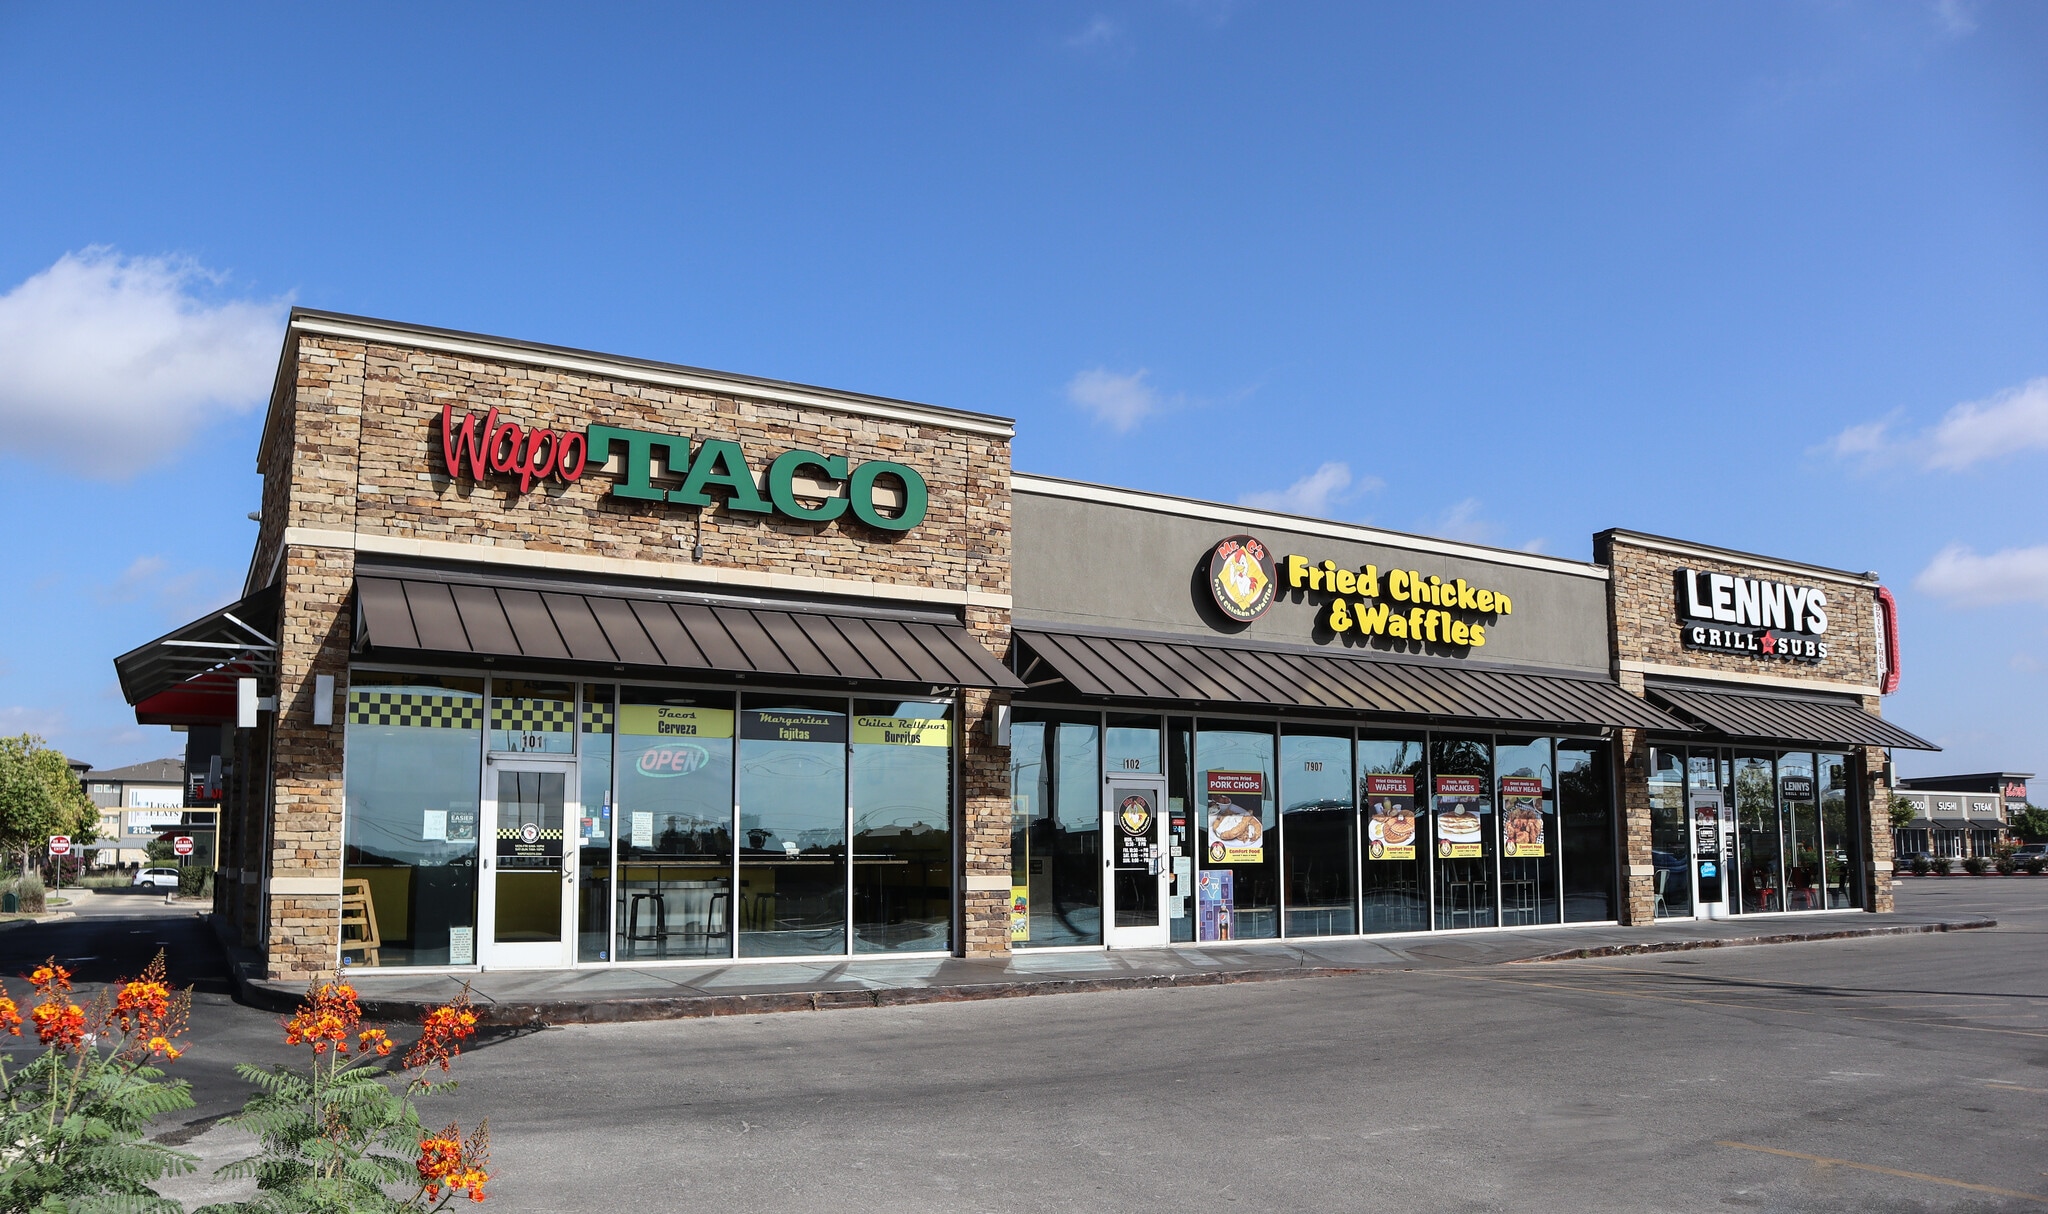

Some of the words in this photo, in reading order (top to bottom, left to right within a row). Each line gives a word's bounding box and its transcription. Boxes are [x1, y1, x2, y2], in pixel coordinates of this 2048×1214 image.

[442, 403, 587, 494] Wapo
[586, 424, 928, 531] TACO
[1218, 541, 1239, 560] Mr.
[1246, 540, 1264, 560] C's
[1288, 554, 1380, 598] Fried
[1389, 569, 1512, 615] Chicken
[1214, 578, 1225, 600] Fried
[1223, 602, 1250, 617] Chicken
[1686, 569, 1828, 635] LENNYS
[1329, 598, 1352, 632] &
[1354, 603, 1487, 648] Waffles
[1875, 604, 1883, 639] DRIVE
[1692, 626, 1758, 650] GRILL
[1778, 638, 1828, 658] SUBS
[1877, 642, 1885, 670] THRU
[658, 708, 696, 719] Tacos
[759, 712, 830, 727] Margaritas
[658, 720, 697, 735] Cerveza
[857, 718, 894, 728] Chiles
[898, 719, 946, 730] Rellenos
[779, 727, 810, 741] Fajitas
[884, 731, 921, 744] Burritos
[522, 735, 543, 748] 101
[641, 749, 701, 772] OPEN
[1126, 759, 1140, 769] 102
[1307, 761, 1323, 771] 7907
[1210, 780, 1232, 788] PORK
[1233, 781, 1260, 789] CHOPS
[1375, 783, 1407, 791] WAFFLES
[1784, 781, 1810, 791] LENNYS
[1937, 801, 1957, 811] SUSHI
[1973, 802, 1993, 812] STEAK
